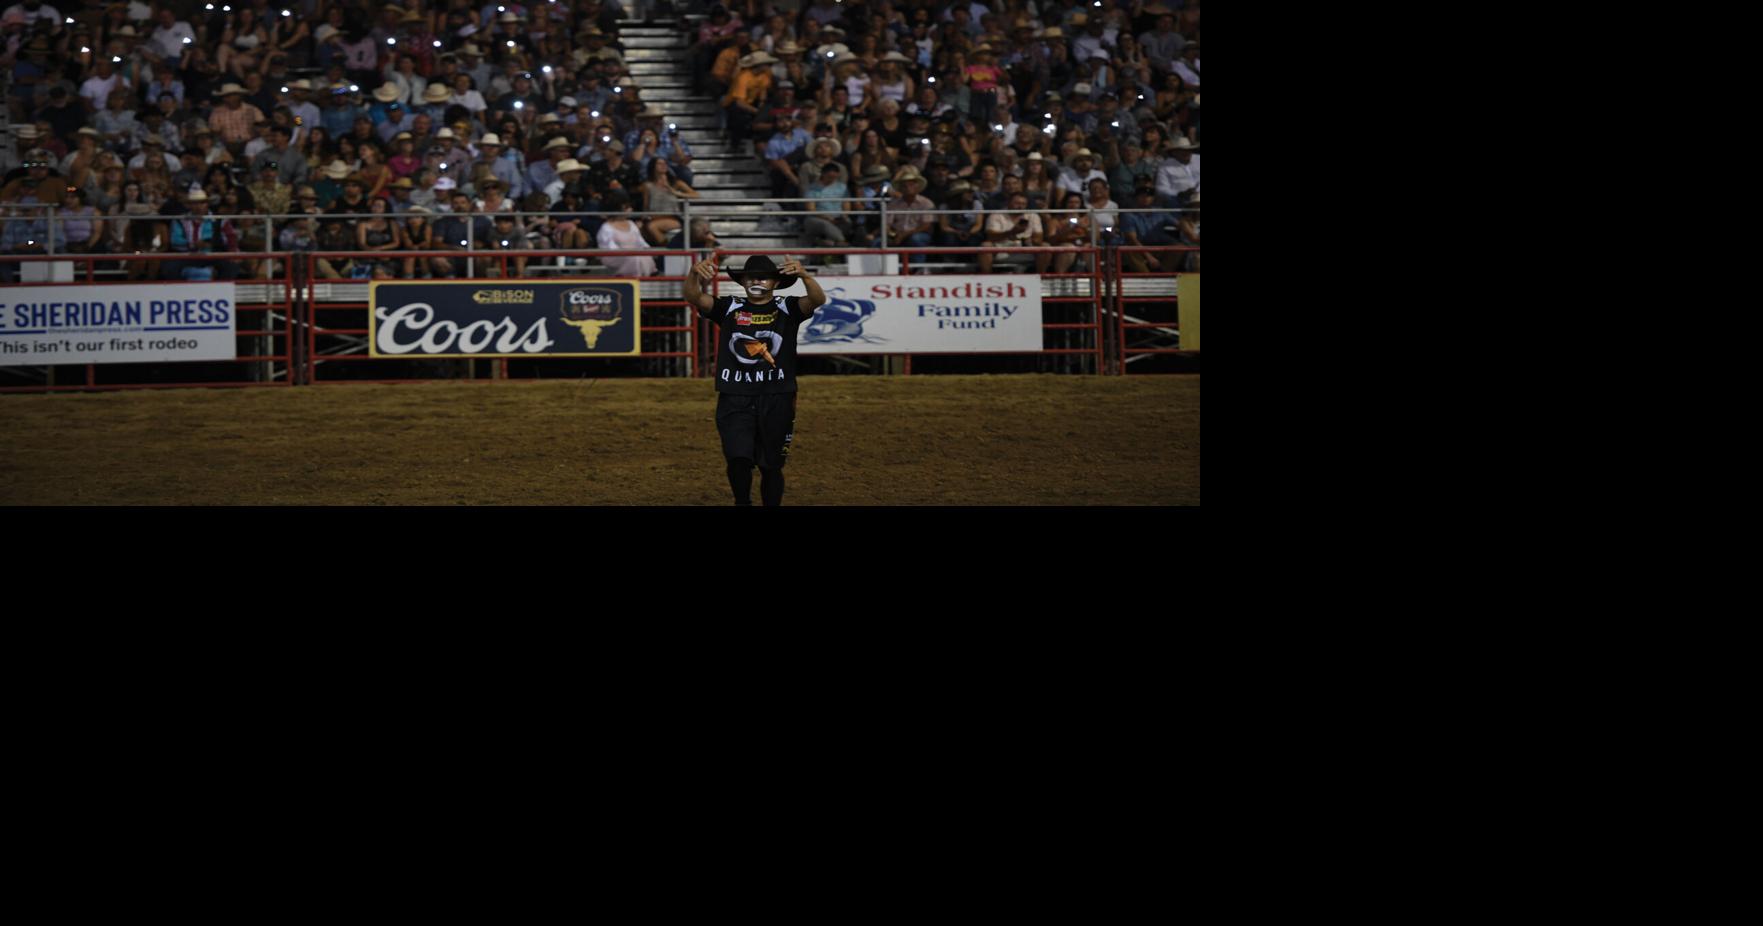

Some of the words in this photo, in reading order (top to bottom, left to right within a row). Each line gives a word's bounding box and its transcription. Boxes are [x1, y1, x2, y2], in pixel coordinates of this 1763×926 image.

[569, 290, 612, 304] Coors
[871, 282, 1026, 299] Standish
[14, 301, 141, 327] SHERIDAN
[150, 299, 230, 325] PRESS
[918, 303, 1018, 319] Family
[376, 302, 554, 354] Coors
[938, 319, 996, 329] Fund
[33, 339, 70, 353] isn't
[76, 341, 104, 352] our
[110, 338, 144, 351] first
[149, 337, 198, 350] rodeo
[721, 368, 785, 383] QUANTA
